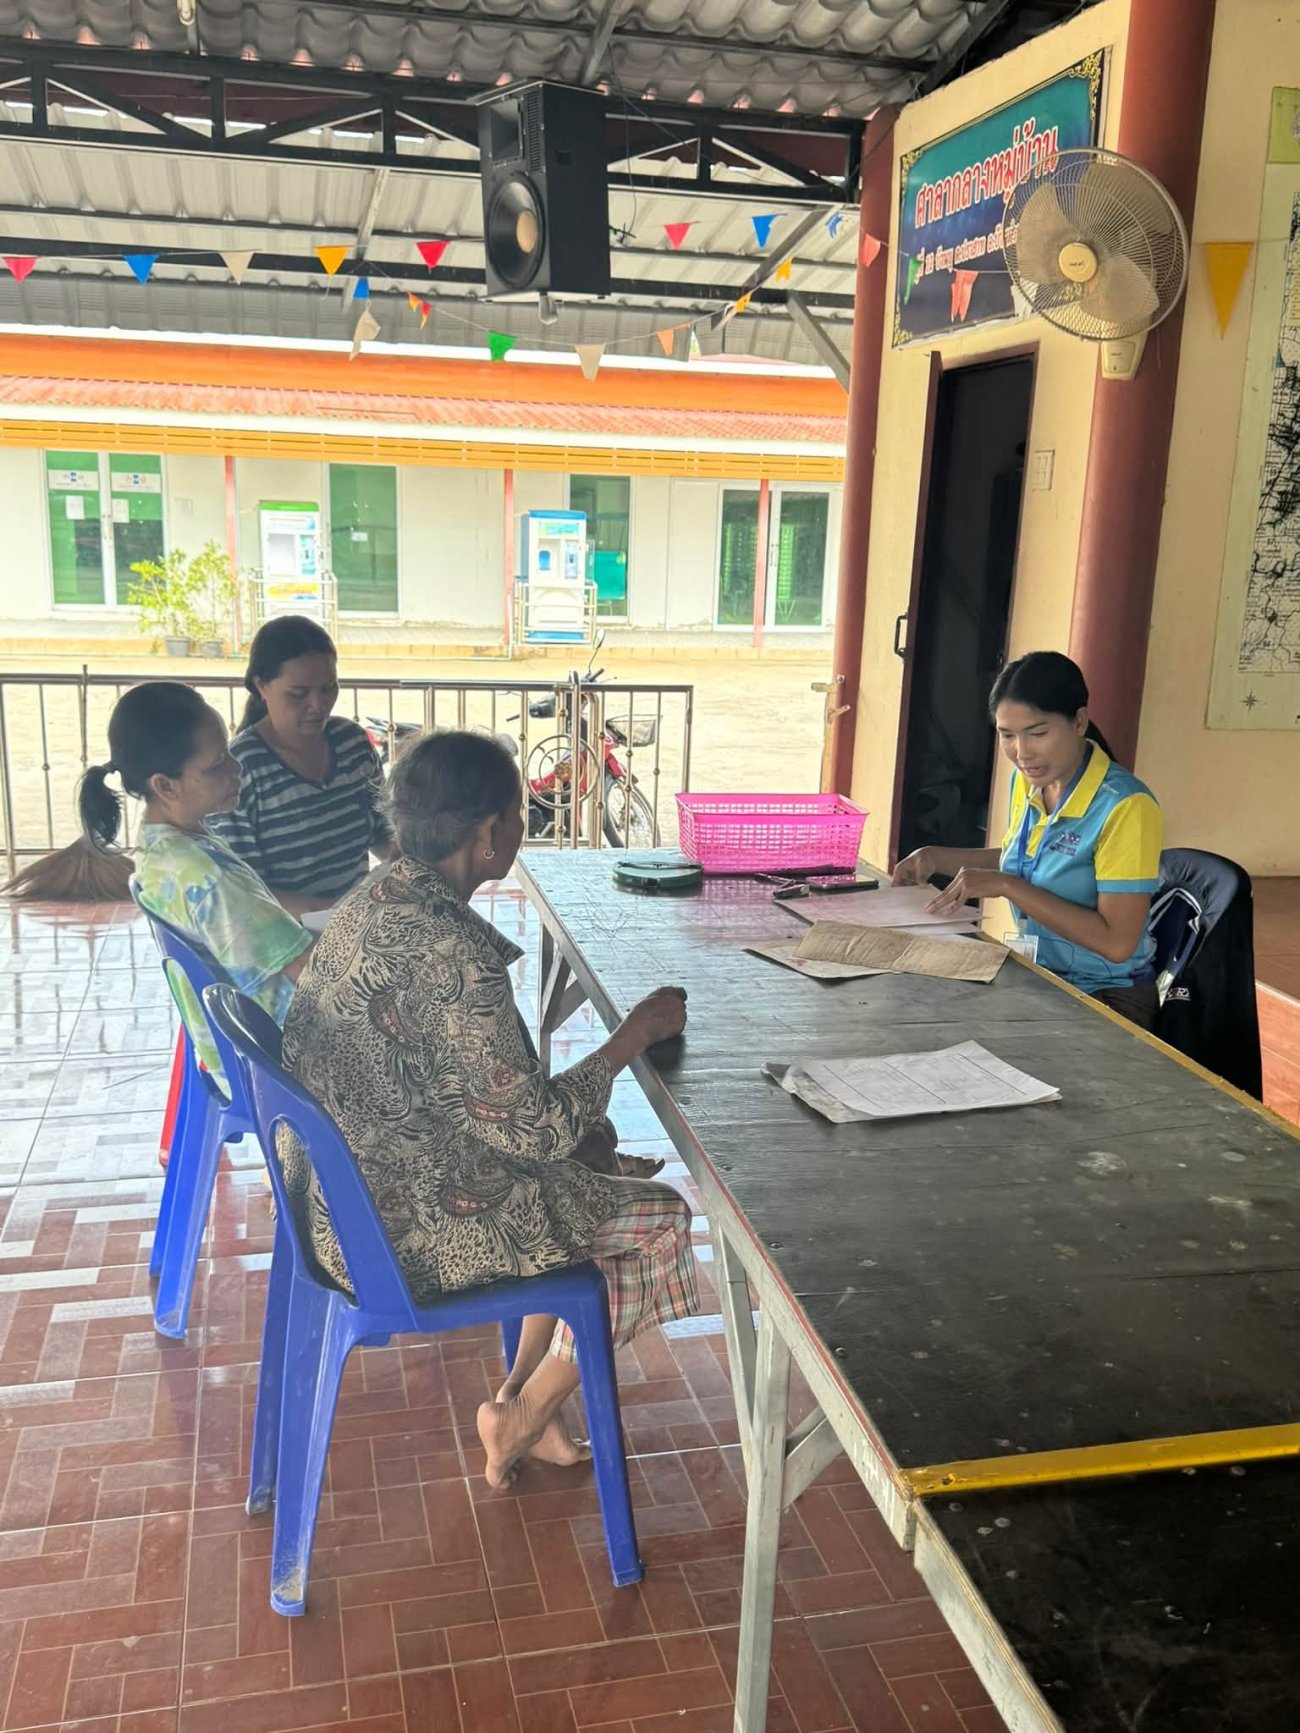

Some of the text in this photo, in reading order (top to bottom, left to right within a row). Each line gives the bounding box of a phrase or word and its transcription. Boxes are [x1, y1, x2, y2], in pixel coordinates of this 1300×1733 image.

[915, 117, 1058, 228] ศาลากลางหมู่บ้าน
